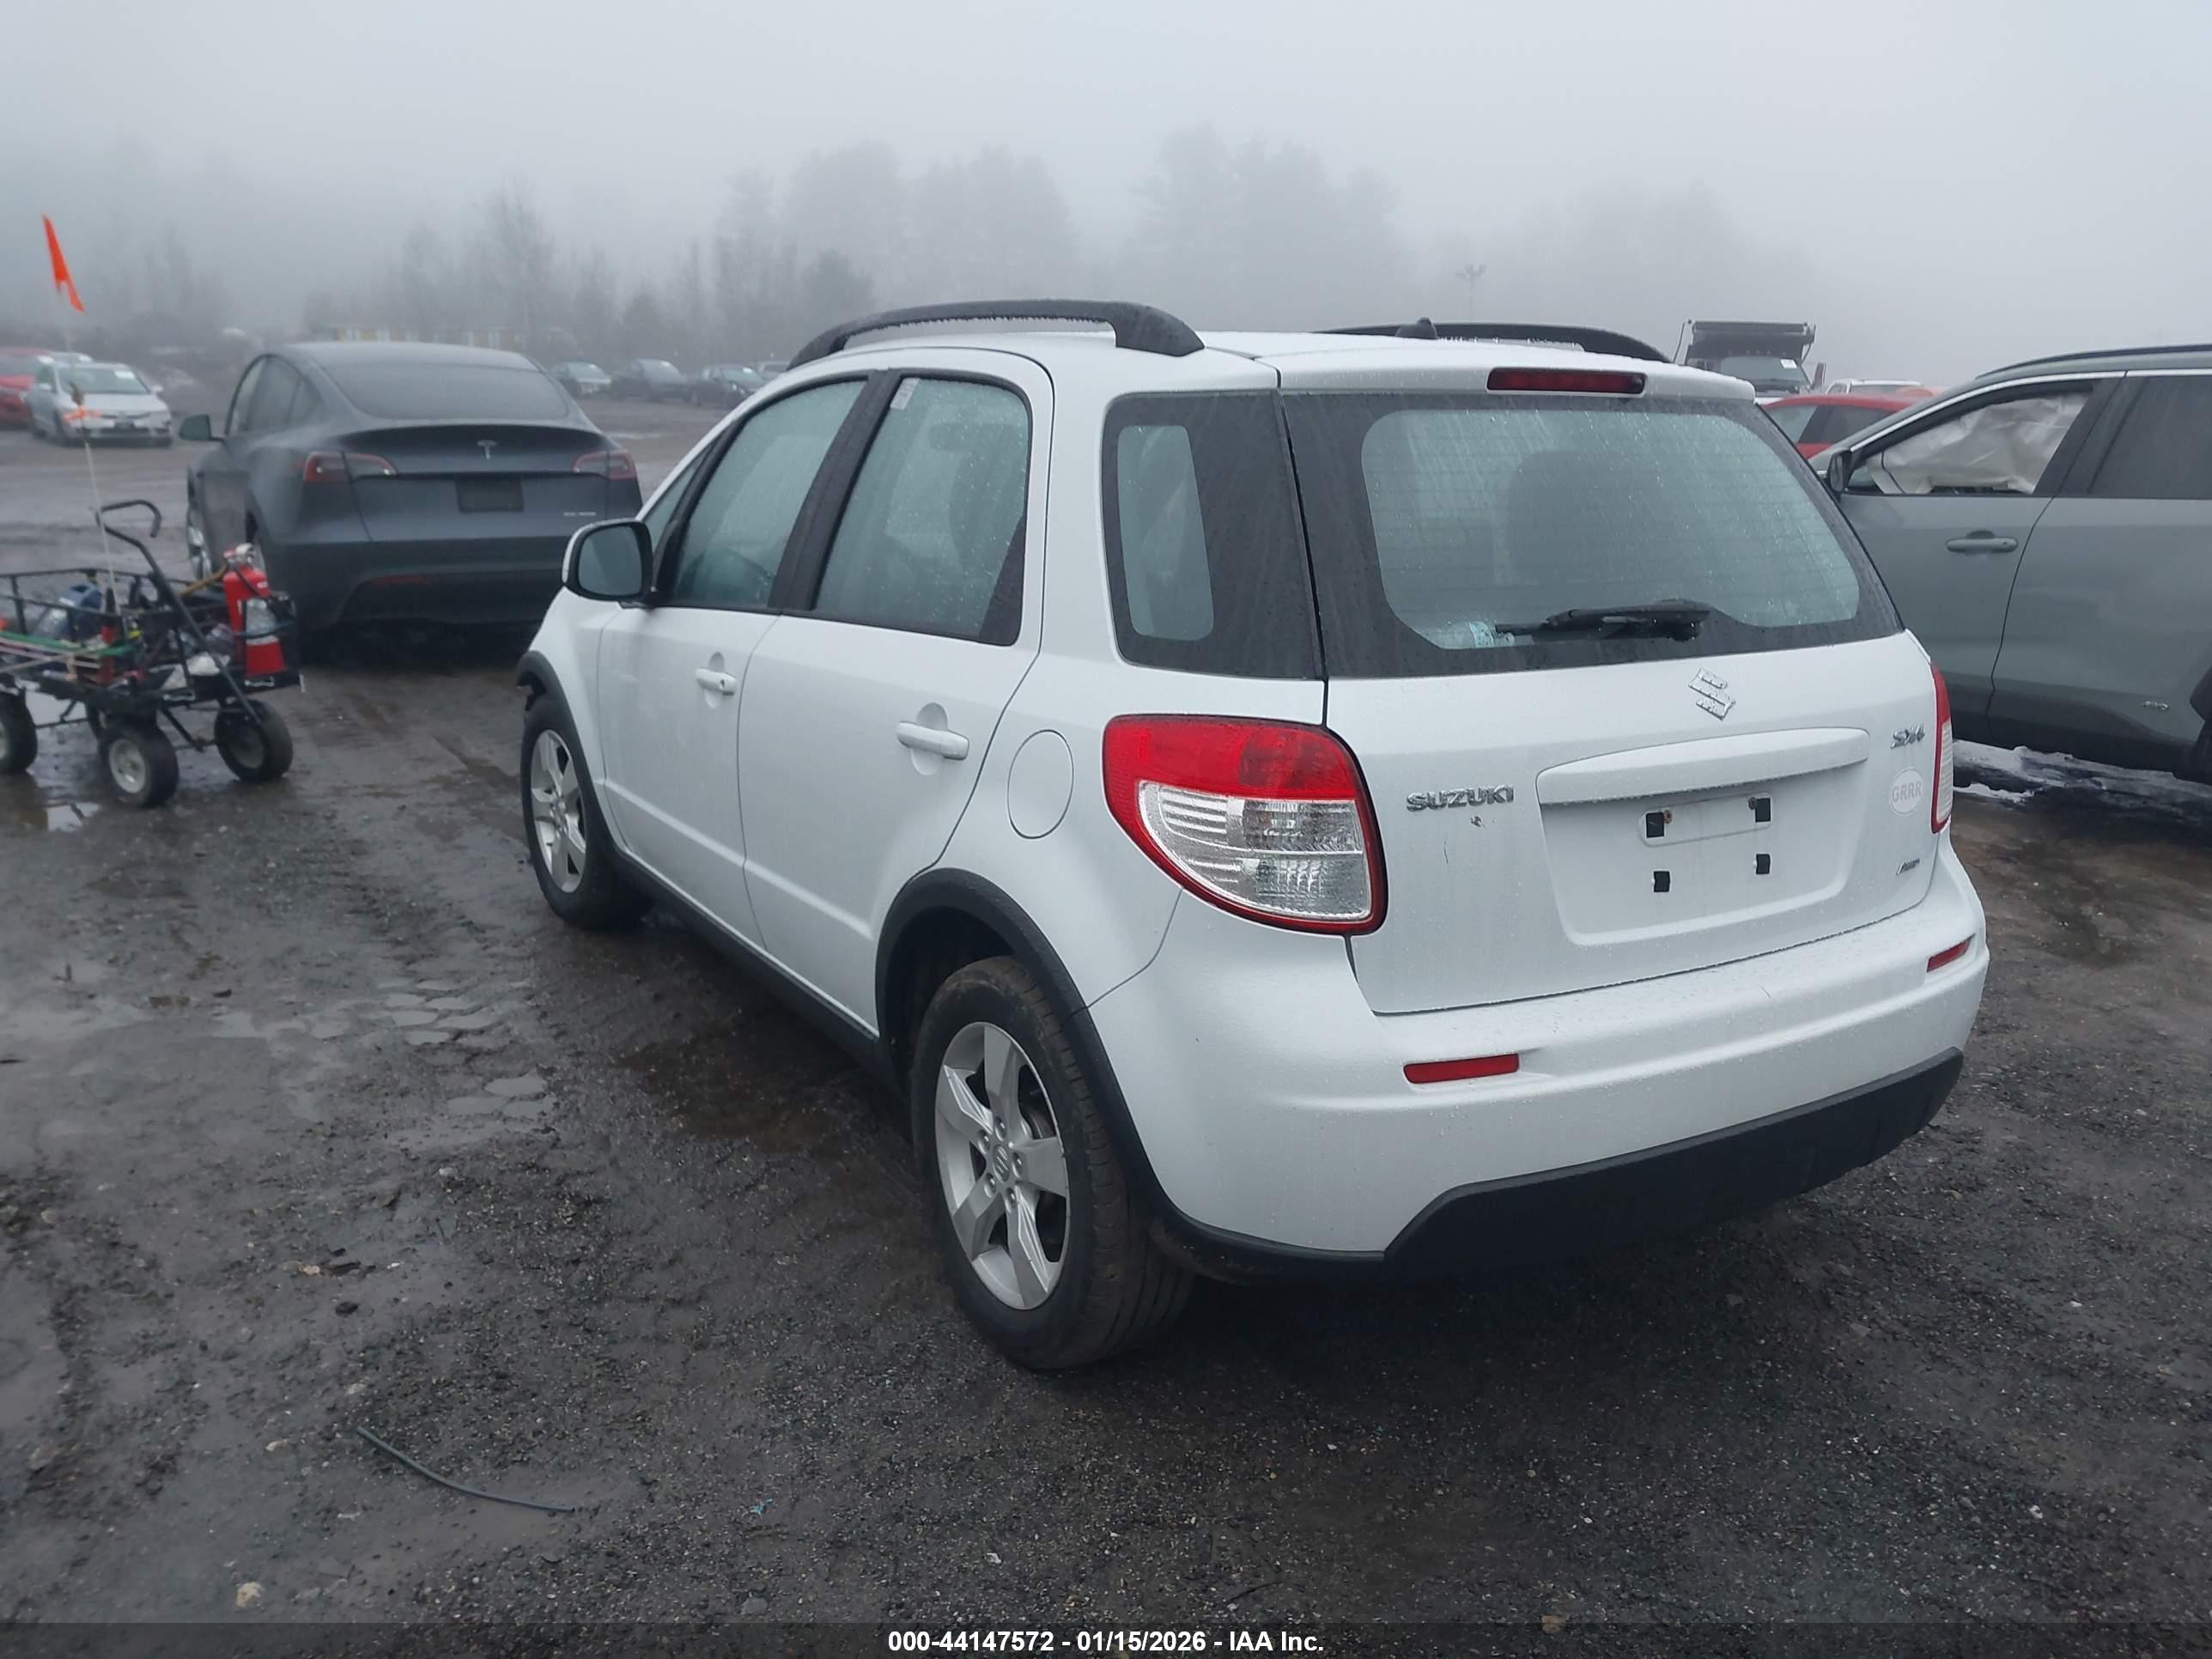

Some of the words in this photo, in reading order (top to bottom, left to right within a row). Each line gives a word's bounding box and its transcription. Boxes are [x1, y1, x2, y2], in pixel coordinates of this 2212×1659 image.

[1891, 724, 1924, 749] SX4
[1406, 785, 1514, 811] SUZUKI
[1892, 781, 1923, 802] GRRR
